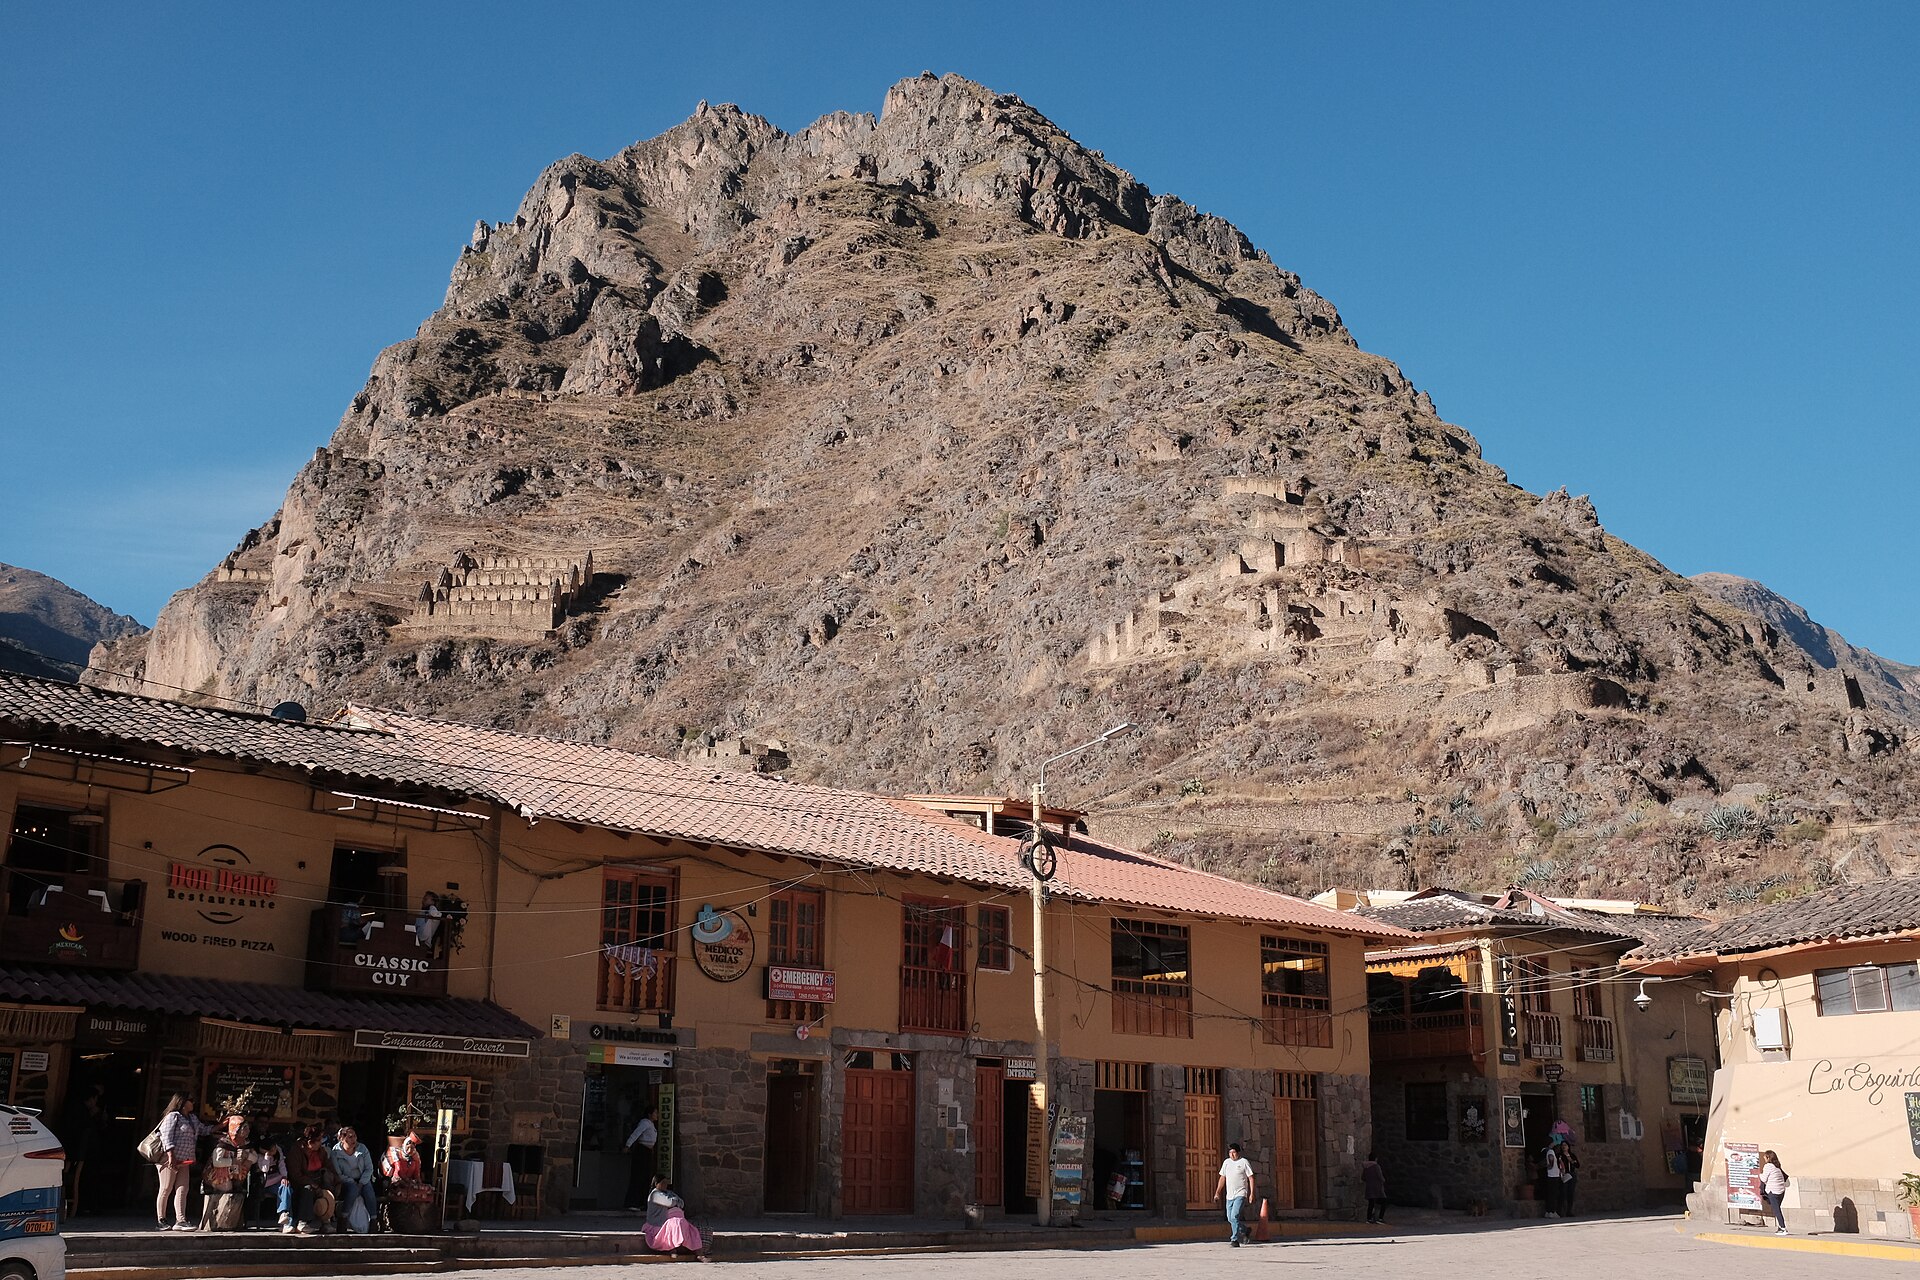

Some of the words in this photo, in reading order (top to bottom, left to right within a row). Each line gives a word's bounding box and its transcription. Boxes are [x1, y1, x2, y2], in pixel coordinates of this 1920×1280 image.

[169, 863, 213, 891] Don
[167, 889, 276, 909] Restaurante
[161, 930, 197, 943] WOOD
[202, 935, 237, 948] FIRED
[241, 939, 275, 952] PIZZA
[736, 929, 750, 943] 24
[55, 942, 83, 950] MEXICAN
[354, 953, 429, 973] CLASSIC
[372, 971, 410, 987] CUY
[782, 970, 824, 987] EMERGENCY
[826, 992, 834, 1000] 24
[90, 1018, 112, 1030] Don
[115, 1019, 148, 1033] Dante
[380, 1031, 445, 1049] Empanadas
[462, 1038, 505, 1053] Desserts
[1007, 1069, 1036, 1078] INTERNE
[1808, 1059, 1844, 1095] La
[1688, 1087, 1707, 1095] EXCHANGE
[660, 1097, 671, 1169] DRUGSTORE
